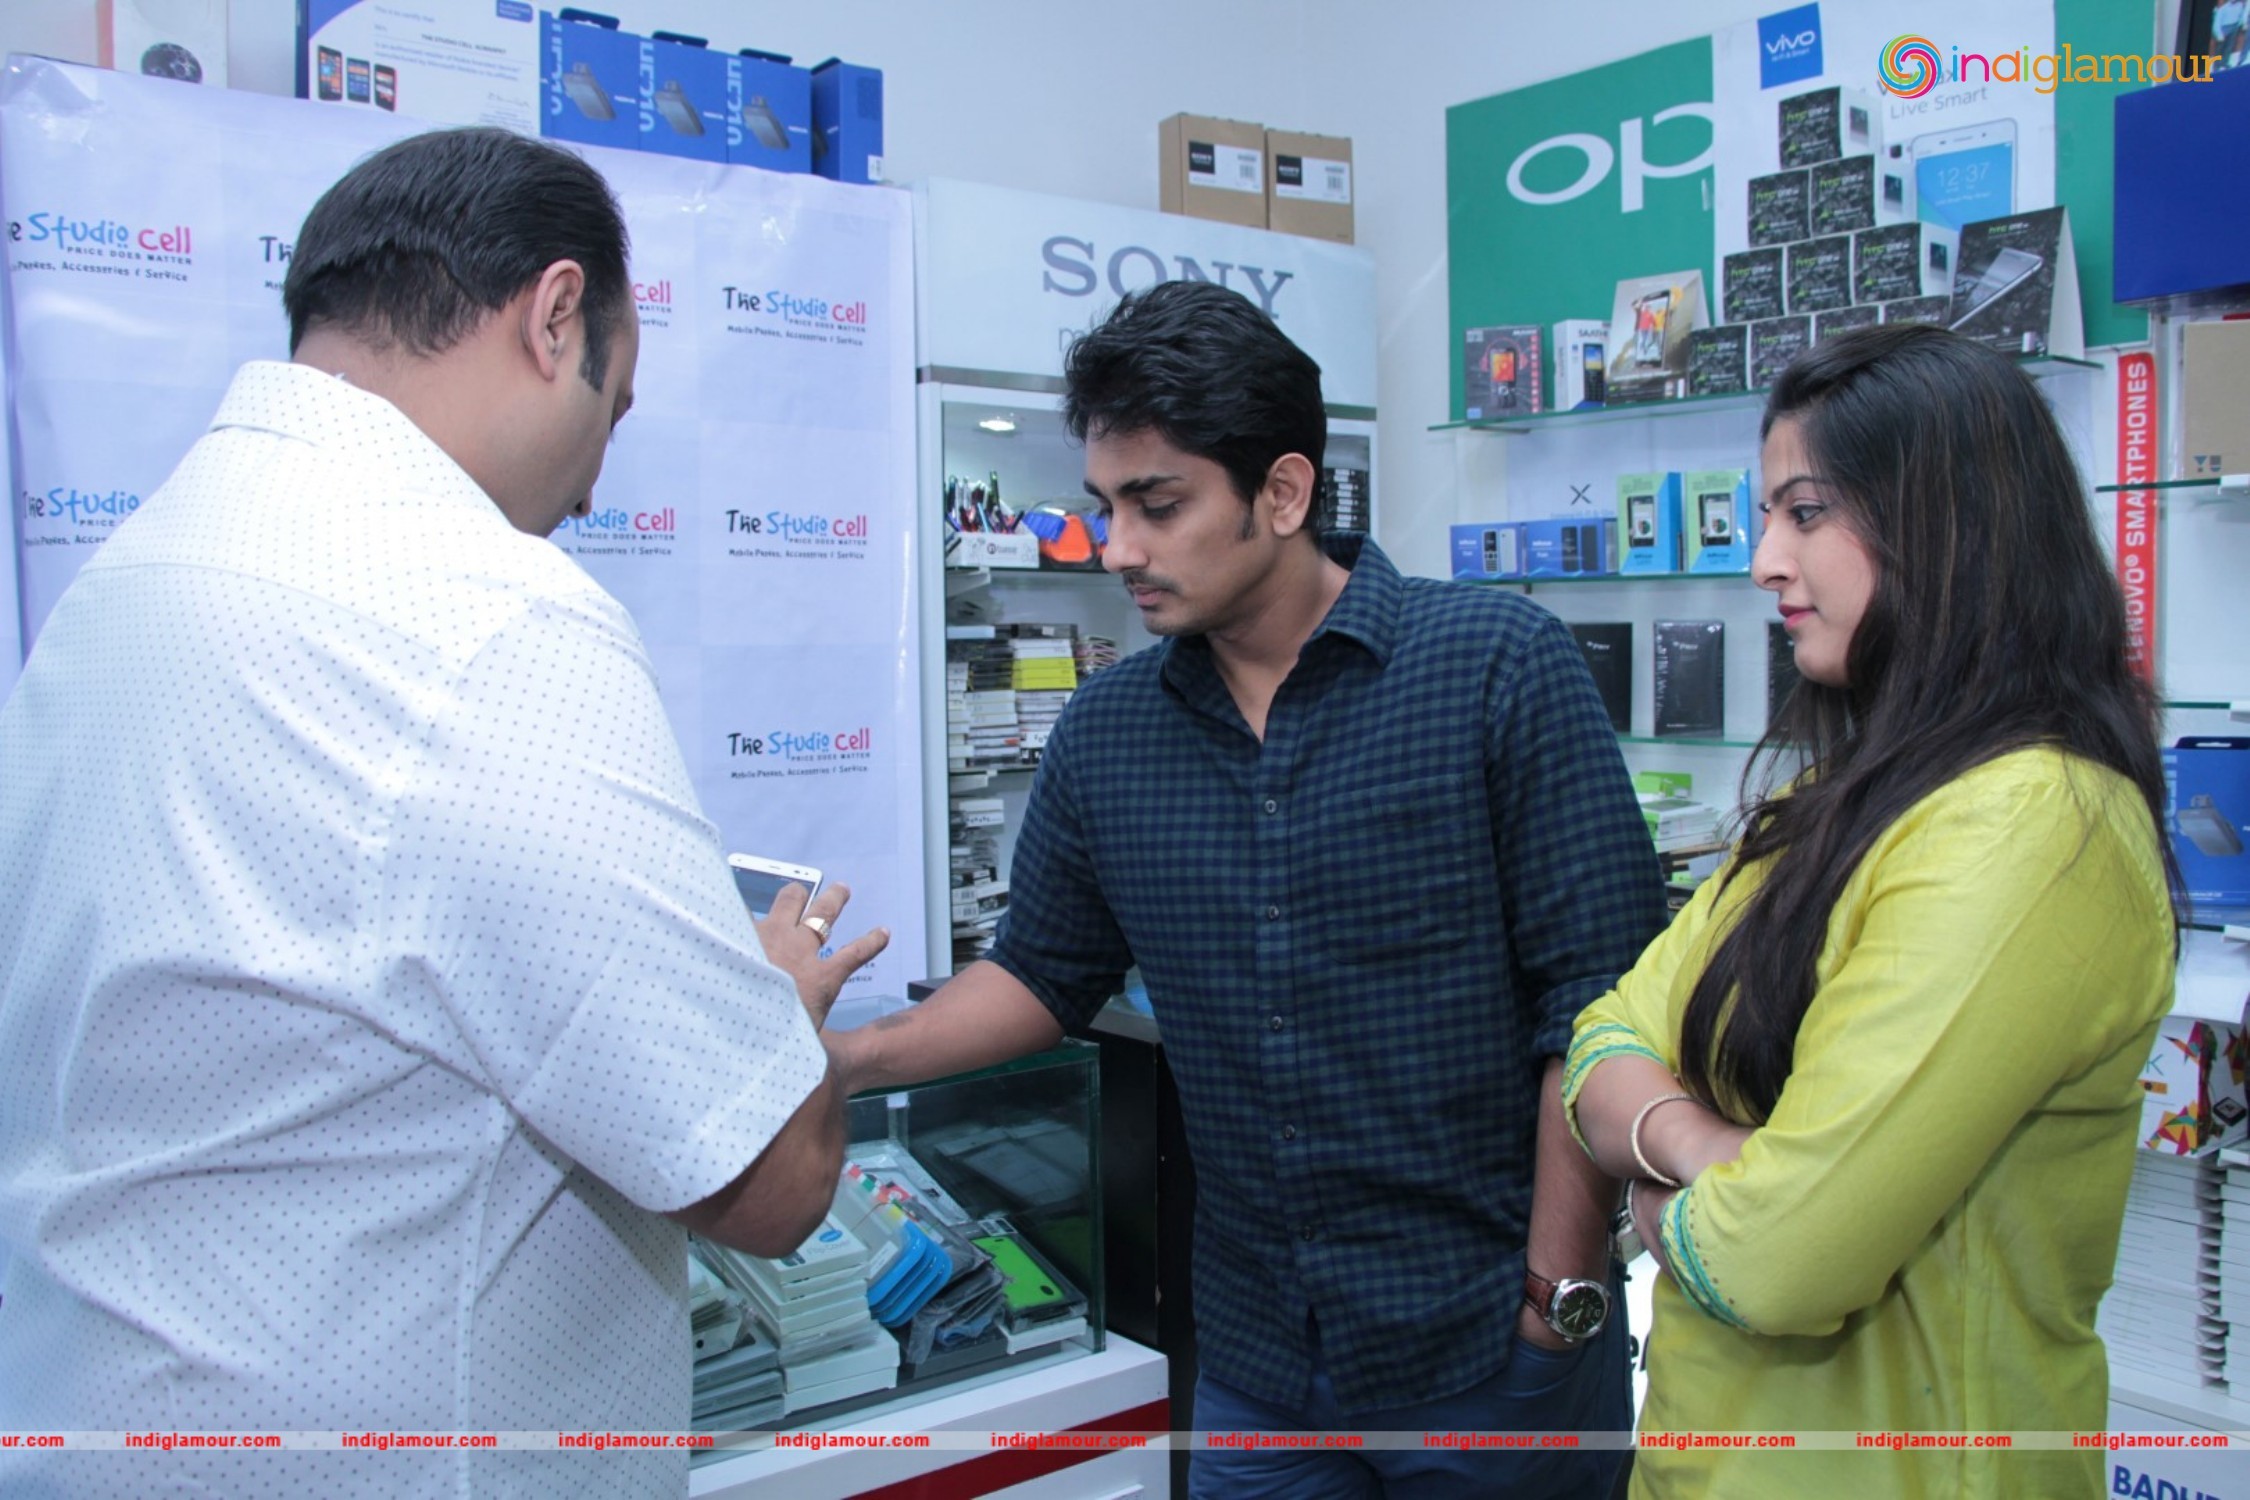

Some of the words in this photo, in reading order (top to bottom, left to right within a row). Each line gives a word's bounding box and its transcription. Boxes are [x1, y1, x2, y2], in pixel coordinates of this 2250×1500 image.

[1890, 100, 1928, 119] Live
[1934, 86, 1988, 112] Smart
[28, 212, 129, 250] Studio
[66, 246, 104, 256] PRICE
[110, 250, 142, 261] DOES
[147, 253, 193, 265] MATTER
[259, 236, 293, 262] Th
[722, 286, 761, 312] The
[765, 290, 828, 321] Studio
[48, 488, 139, 523] Studio
[79, 519, 115, 527] PRICE
[725, 509, 761, 533] The
[766, 511, 828, 541] Studio
[727, 732, 763, 757] The
[767, 731, 830, 760] Studio
